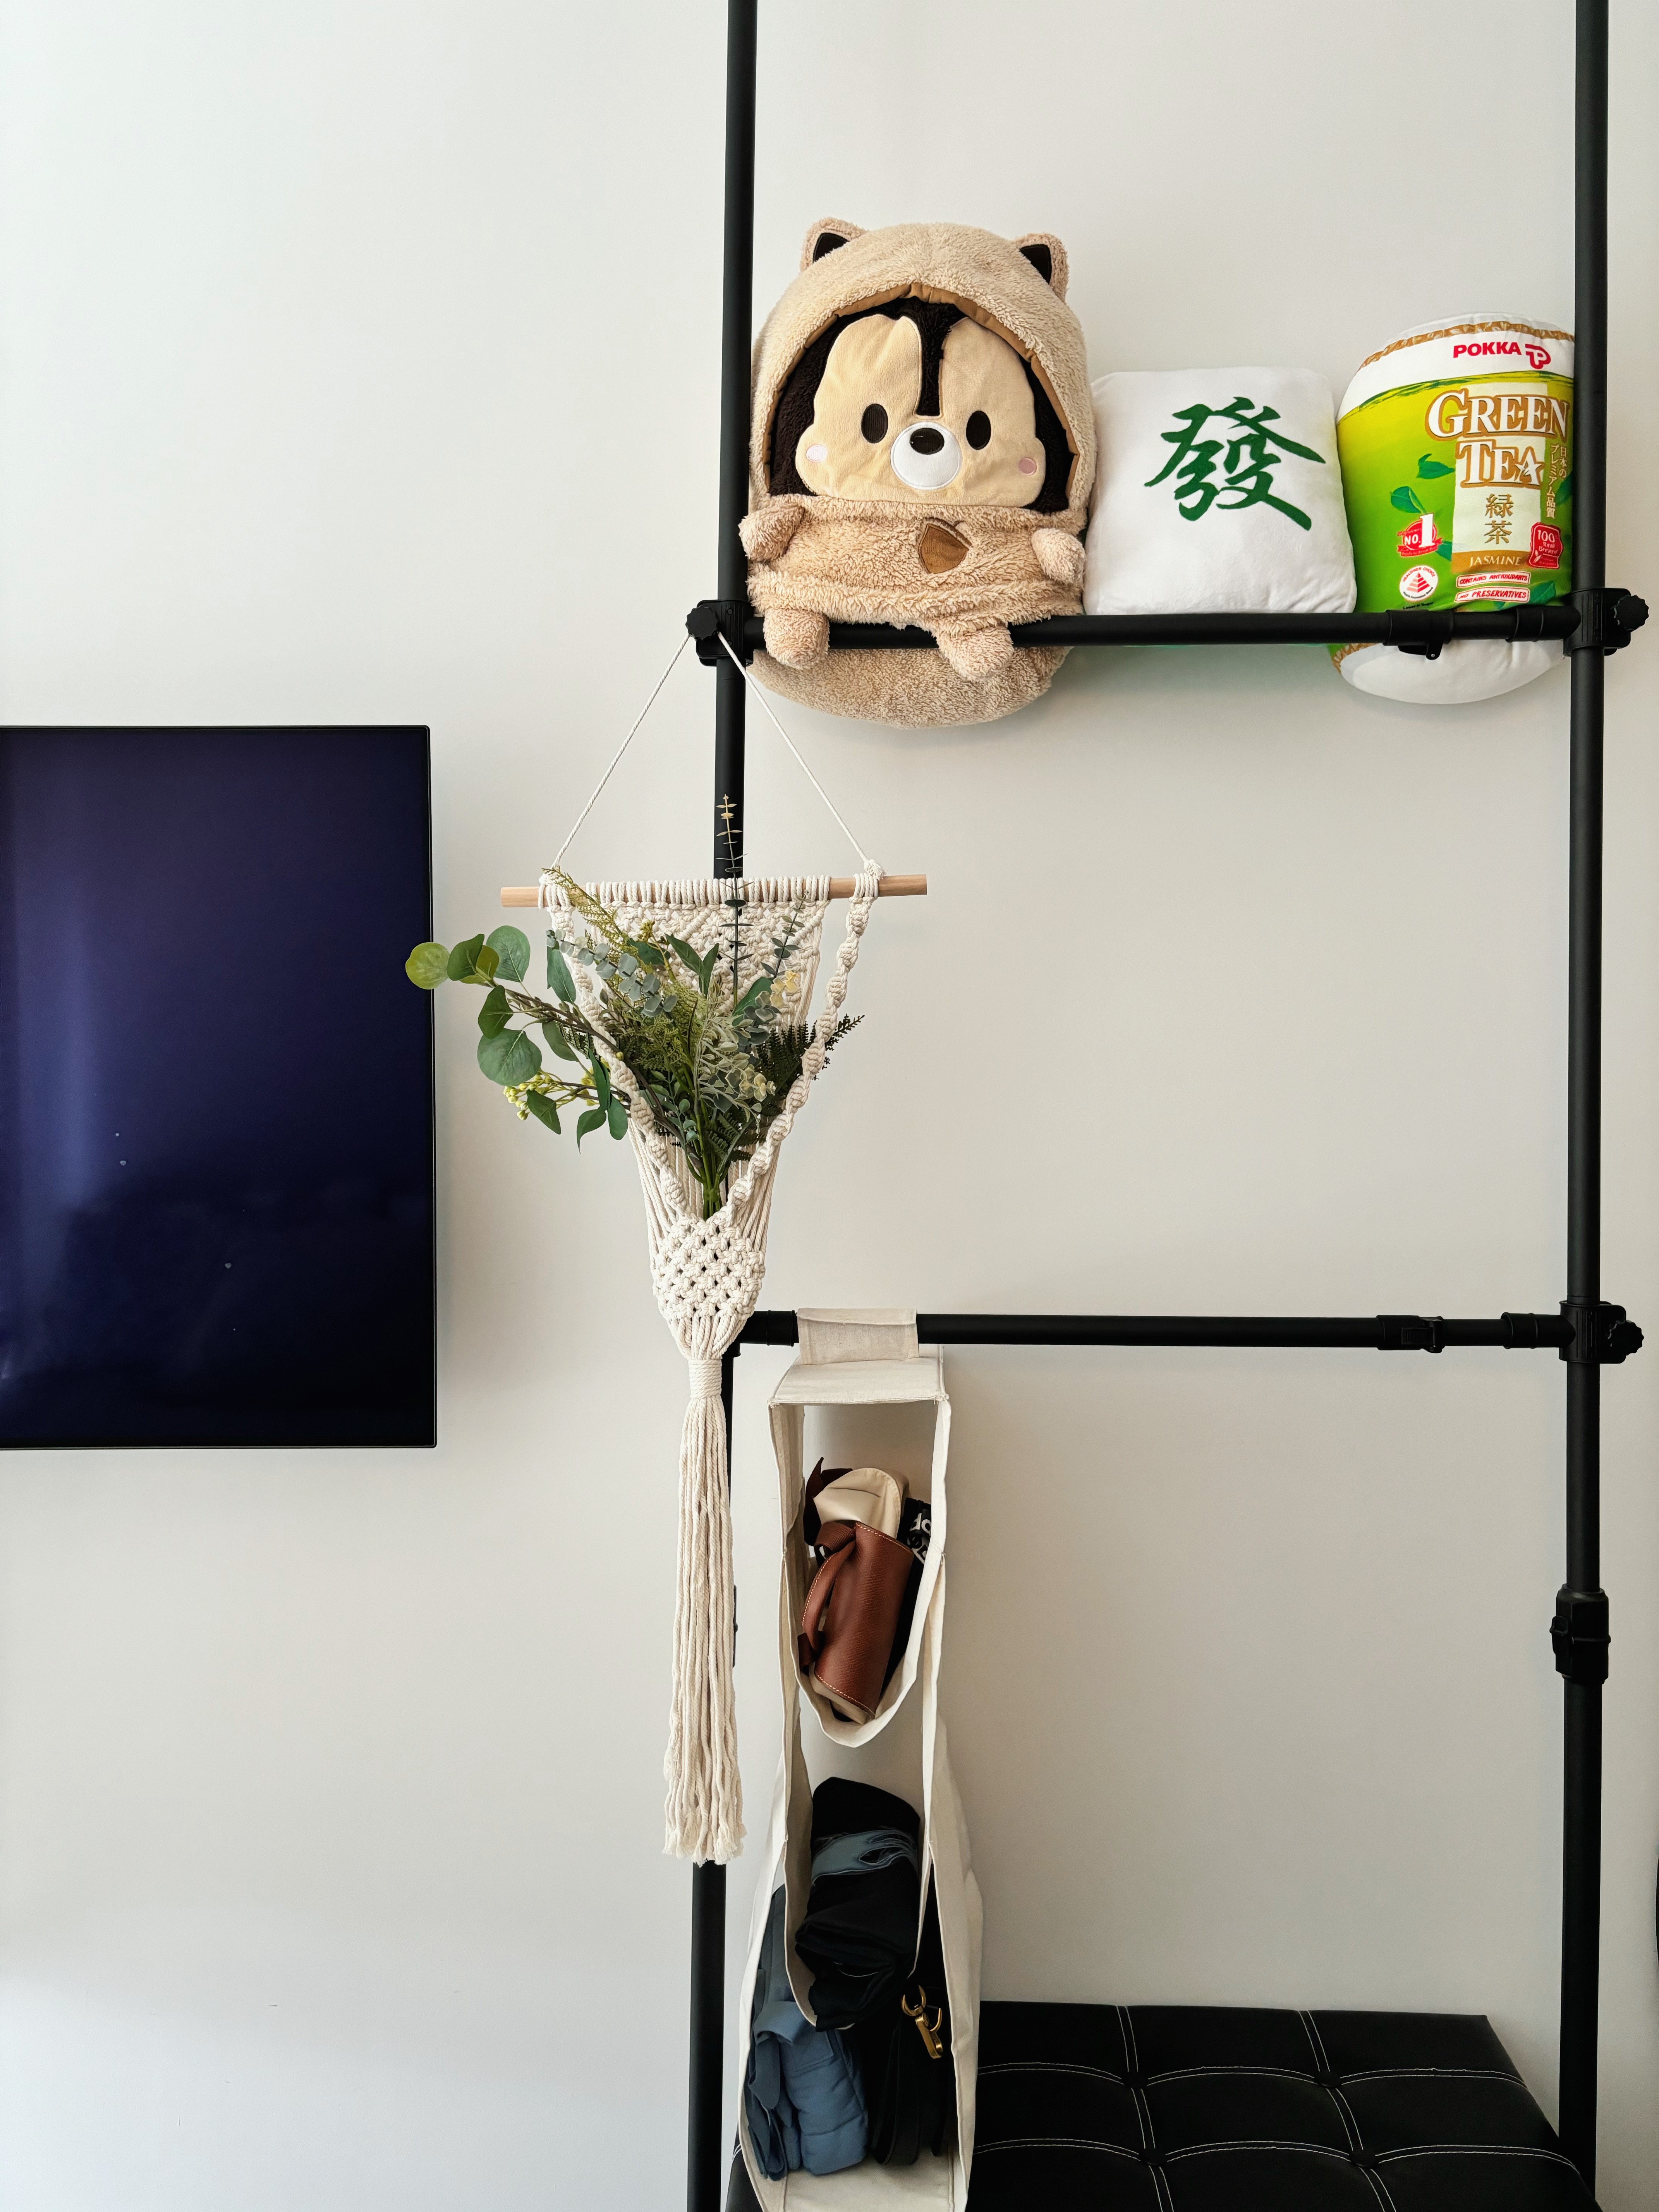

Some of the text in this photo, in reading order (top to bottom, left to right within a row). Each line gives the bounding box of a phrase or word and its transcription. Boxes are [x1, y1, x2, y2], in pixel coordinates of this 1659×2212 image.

[1453, 342, 1522, 358] POKKA
[1427, 390, 1569, 441] GREEN
[1144, 396, 1326, 531] 發
[1457, 440, 1544, 487] TEA
[1559, 446, 1567, 478] 日本の
[1469, 556, 1522, 568] JASMINE
[1459, 575, 1487, 584] CONTAINS
[1472, 590, 1527, 599] PRESERVATIVES
